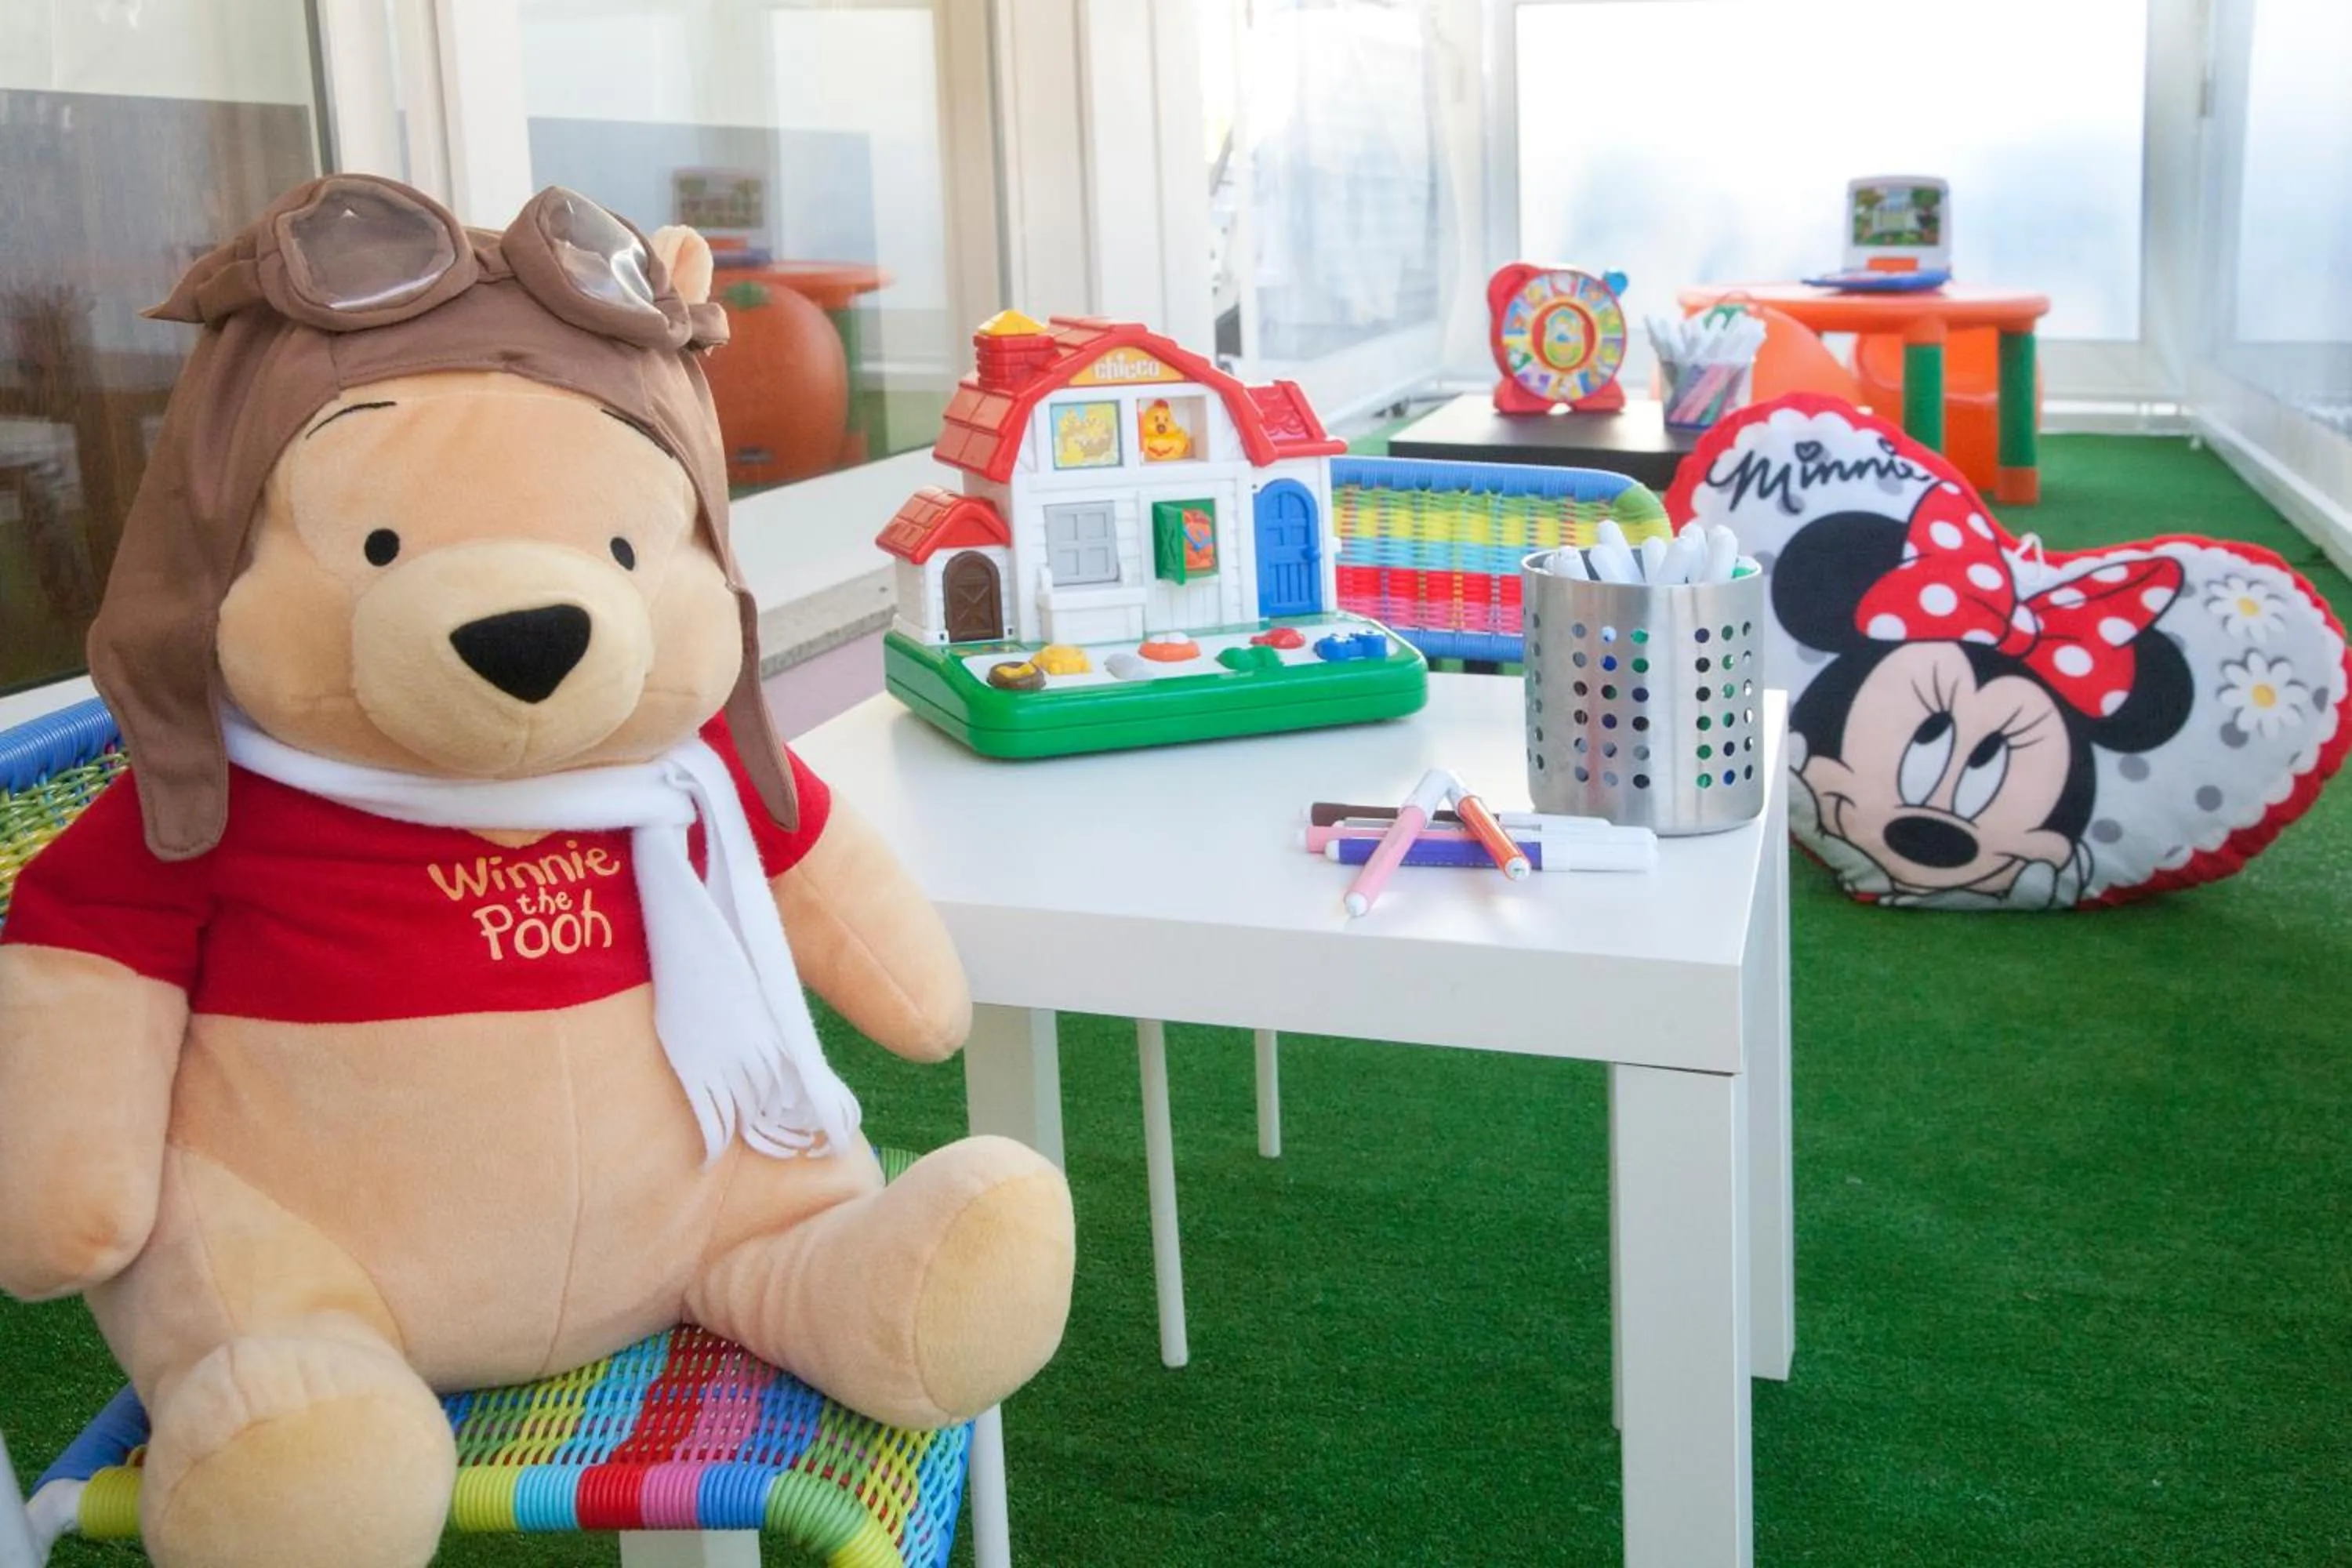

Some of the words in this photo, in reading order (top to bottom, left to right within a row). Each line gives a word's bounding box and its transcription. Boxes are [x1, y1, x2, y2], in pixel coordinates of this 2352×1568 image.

[1094, 352, 1160, 379] chicco
[1706, 437, 1930, 514] Minnie
[427, 840, 620, 901] Winnie
[516, 887, 573, 915] the
[472, 888, 612, 960] Pooh
